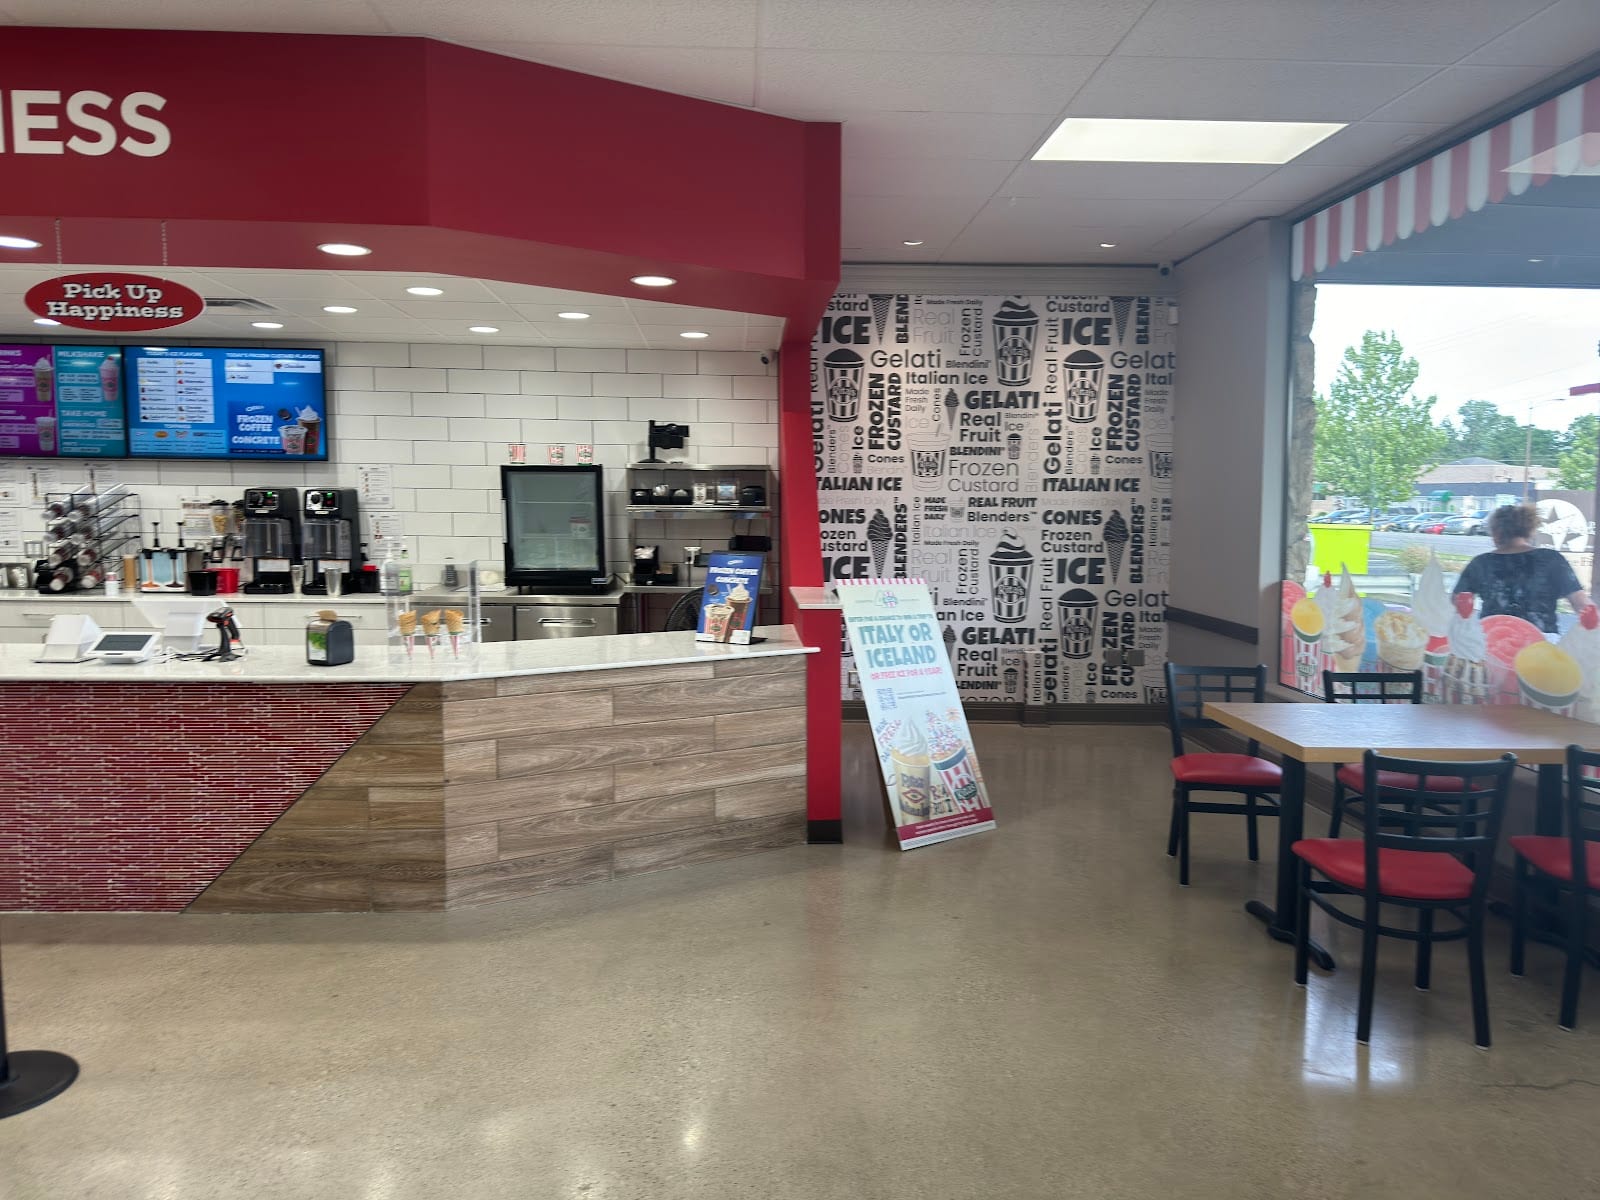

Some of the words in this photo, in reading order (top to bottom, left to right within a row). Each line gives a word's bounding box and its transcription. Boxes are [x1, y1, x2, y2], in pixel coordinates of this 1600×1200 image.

[0, 90, 171, 158] ESS
[63, 282, 122, 300] Pick
[125, 284, 163, 304] Up
[46, 301, 184, 320] Happiness
[827, 301, 869, 312] stard
[1046, 301, 1110, 313] Custard
[821, 316, 872, 345] ICE
[960, 308, 972, 356] Frozen
[973, 308, 983, 357] Custard
[1044, 318, 1059, 353] Fruit
[1062, 317, 1113, 346] ICE
[870, 349, 942, 368] Gelati
[906, 372, 960, 385] Italian
[963, 372, 988, 385] Ice
[1044, 358, 1057, 394] Real
[964, 390, 1040, 410] GELATI
[236, 414, 274, 424] FROZEN
[868, 373, 885, 450] FROZEN
[887, 373, 901, 450] CUSTARD
[960, 412, 1001, 427] Real
[1106, 374, 1124, 451] FROZEN
[1125, 373, 1142, 452] CUSTARD
[238, 423, 273, 432] COFFEE
[960, 428, 1002, 443] Fruit
[1004, 421, 1025, 432] Ice
[852, 426, 864, 450] Ice
[1042, 401, 1062, 475] Gelati
[1089, 427, 1102, 451] Ice
[867, 454, 905, 464] Cones
[949, 459, 1020, 477] Frozen
[1105, 455, 1144, 464] Cones
[817, 477, 873, 491] TALIAN
[878, 477, 903, 491] ICE
[948, 478, 1020, 493] Custard
[1042, 477, 1110, 492] ITALIAN
[1114, 478, 1141, 492] ICE
[911, 496, 921, 512] Ice
[968, 497, 999, 508] REAL
[1001, 497, 1038, 508] FRUIT
[818, 508, 867, 524] ONES
[1042, 509, 1103, 526] CONES
[821, 530, 857, 540] ozen
[911, 514, 921, 546] Italian
[1041, 529, 1093, 541] Frozen
[1041, 541, 1105, 554] Custard
[956, 549, 968, 594] Frozen
[969, 548, 980, 595] Custard
[1040, 557, 1054, 592] Fruit
[1056, 557, 1107, 585] ICE
[960, 611, 985, 622] Ice
[1040, 597, 1053, 631] Real
[858, 624, 904, 646] ITALY
[909, 622, 934, 643] OR
[962, 627, 1035, 646] GELATI
[864, 645, 937, 669] ICELAND
[958, 647, 998, 662] Real
[1101, 612, 1119, 686] FRZEN
[1120, 611, 1135, 687] CUTARD
[957, 663, 998, 677] Fruit
[1001, 656, 1021, 666] Ice
[1085, 662, 1098, 686] Ice
[1101, 689, 1138, 699] Cones
